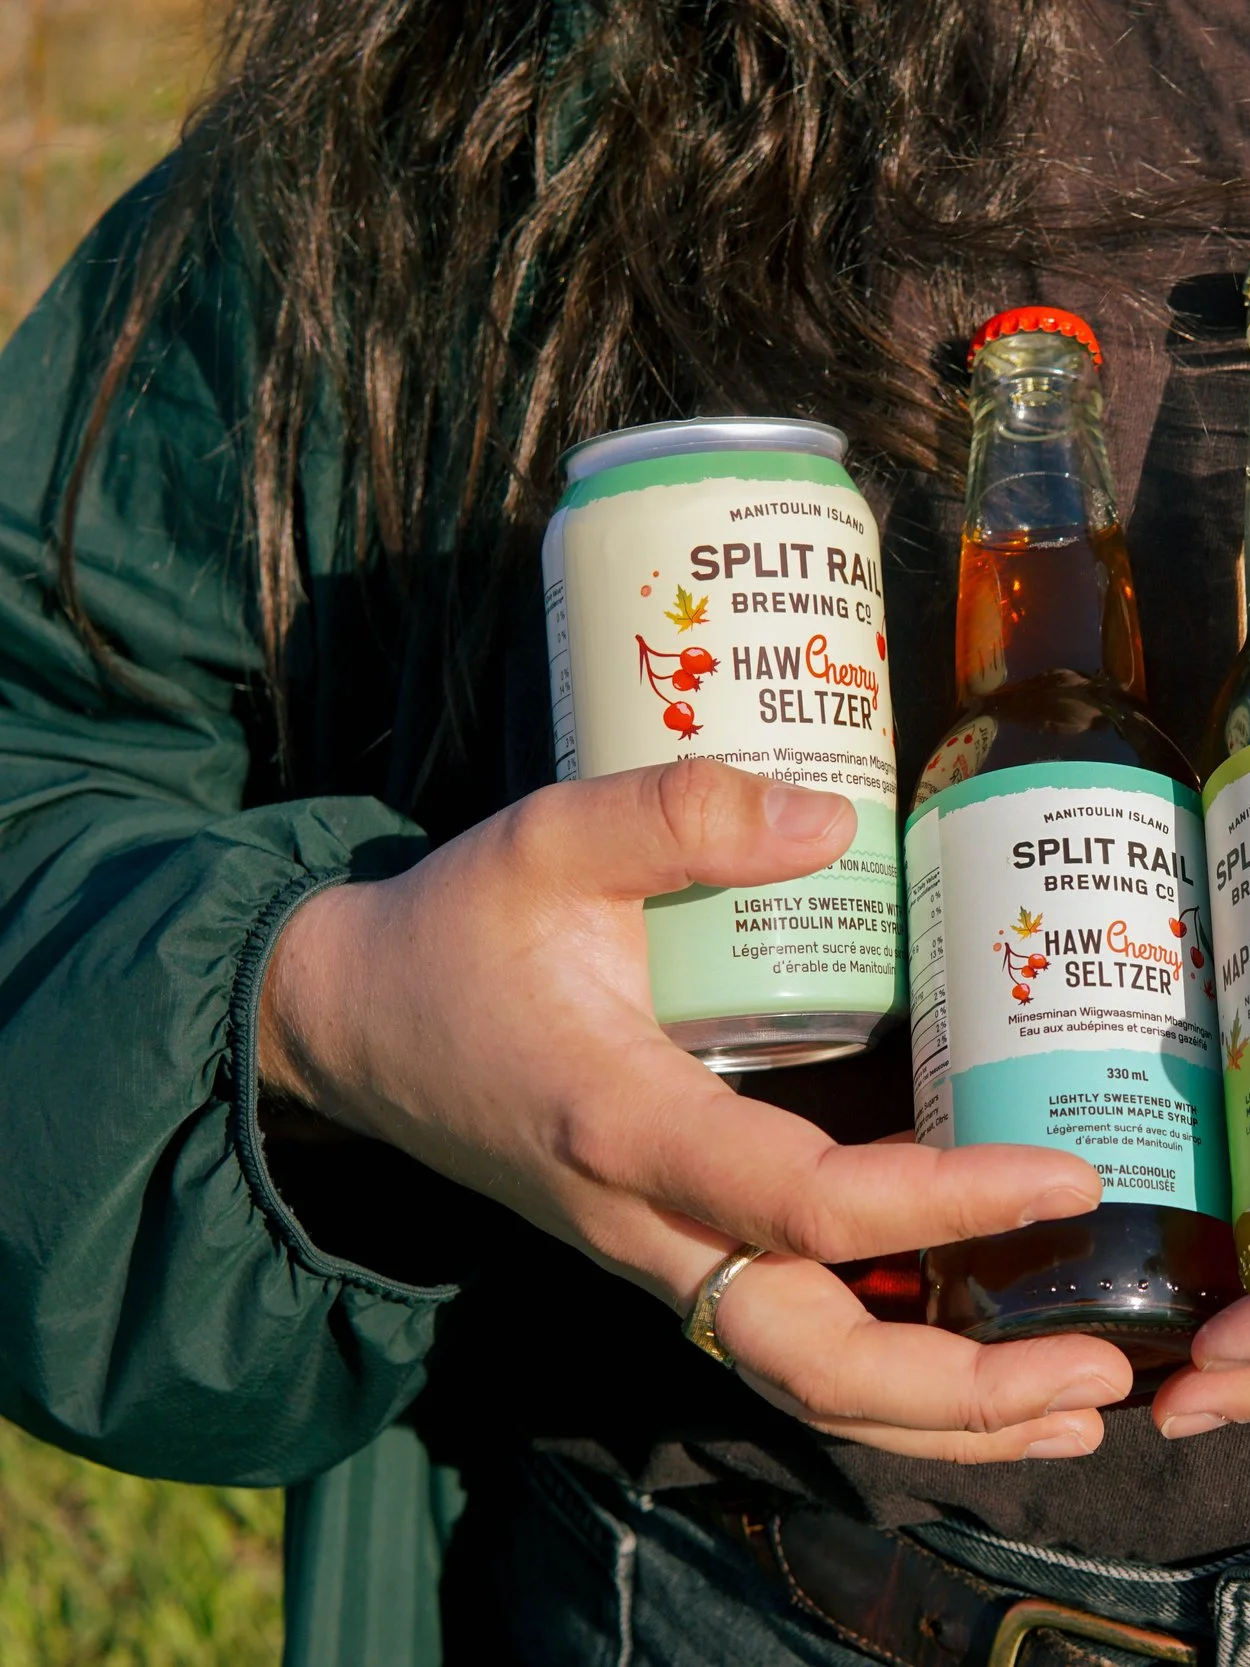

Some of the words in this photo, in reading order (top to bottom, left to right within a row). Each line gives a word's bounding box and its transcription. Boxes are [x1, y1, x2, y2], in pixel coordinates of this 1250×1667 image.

[729, 502, 822, 523] MANITOULIN
[826, 506, 865, 535] ISLAND
[690, 543, 814, 581] SPLIT
[827, 546, 882, 599] RAIL
[731, 592, 849, 619] BREWING
[732, 646, 801, 681] HAW
[805, 634, 879, 711] Cherry
[759, 688, 873, 731] SELTZER
[773, 748, 868, 767] Wiigwaasminan
[831, 771, 843, 784] et
[845, 773, 881, 789] cerises
[1043, 806, 1123, 823] MANITOULIN
[1128, 810, 1170, 835] ISLAND
[840, 858, 861, 872] NON
[1012, 837, 1115, 869] SPLIT
[1127, 840, 1194, 886] RAIL
[1044, 874, 1148, 896] BREWING
[734, 897, 802, 914] LIGHTLY
[808, 897, 884, 914] SWEETENED
[735, 916, 833, 933] MANITOULIN
[838, 916, 878, 932] MAPLE
[732, 941, 819, 960] Légèrement
[822, 941, 857, 955] sucré
[859, 944, 881, 956] avec
[883, 945, 893, 957] du
[1044, 928, 1102, 956] HAW
[1106, 920, 1182, 981] Cherry
[773, 959, 829, 975] d'érable
[832, 959, 847, 973] de
[850, 960, 896, 976] Manitoulin
[1065, 961, 1172, 996] SELTZER
[1008, 1007, 1077, 1025] Miinesminan
[1079, 1006, 1163, 1023] Wiigwaasminan
[1164, 1014, 1213, 1041] Mbagmingan
[1019, 1024, 1040, 1038] Eau
[1043, 1024, 1063, 1035] aux
[1066, 1020, 1124, 1036] aubépines
[1127, 1022, 1138, 1033] et
[1140, 1024, 1176, 1040] cerises
[1178, 1032, 1208, 1051] gazéifié
[1106, 1068, 1129, 1081] 330
[1131, 1070, 1149, 1082] mL
[1048, 1093, 1099, 1106] LIGHTLY
[1103, 1093, 1171, 1109] SWEETENED
[1174, 1100, 1198, 1115] WITH
[1049, 1104, 1124, 1118] MANITOULIN
[1127, 1106, 1164, 1120] MAPLE
[1167, 1111, 1199, 1127] SYRUP
[1046, 1123, 1111, 1136] Légèrement
[1114, 1122, 1143, 1134] sucré
[1145, 1126, 1167, 1138] avec
[1169, 1128, 1181, 1140] du
[1182, 1131, 1203, 1146] sirop
[1075, 1134, 1119, 1147] d'érable
[1121, 1135, 1134, 1146] de
[1136, 1137, 1183, 1152] Manitoulin
[1093, 1164, 1176, 1180] ON-ALCOHOLIC
[1117, 1177, 1176, 1193] ALCOOLISÉE
